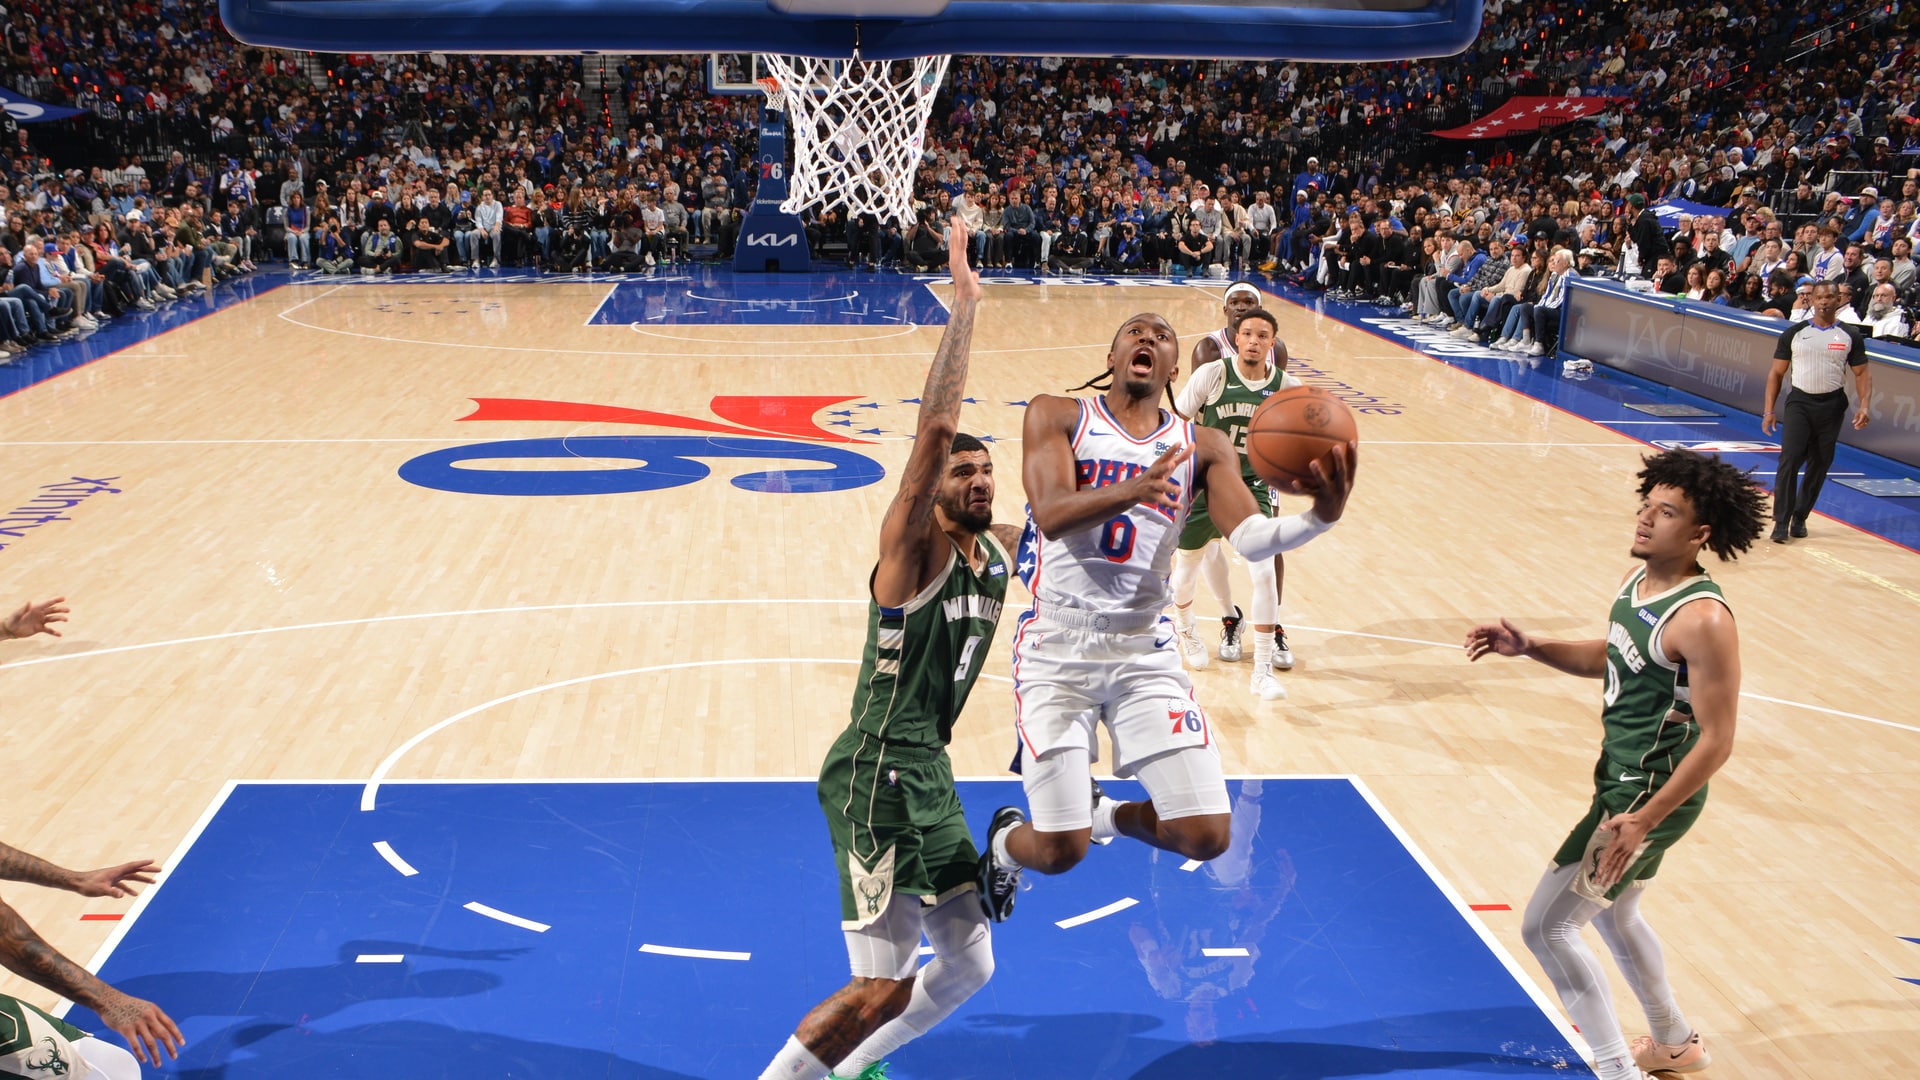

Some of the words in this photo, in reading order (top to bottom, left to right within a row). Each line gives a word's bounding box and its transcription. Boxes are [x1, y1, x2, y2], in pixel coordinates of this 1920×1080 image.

[761, 162, 783, 180] 76
[746, 232, 798, 247] KIA
[1613, 310, 1698, 373] JAG
[1704, 331, 1751, 365] PHYSICAL
[1702, 360, 1747, 395] THERAPY
[1074, 458, 1183, 523] PHIA
[1100, 514, 1137, 564] 0
[1638, 608, 1659, 627] ULINE
[953, 635, 984, 682] 9
[1168, 710, 1202, 735] 76
